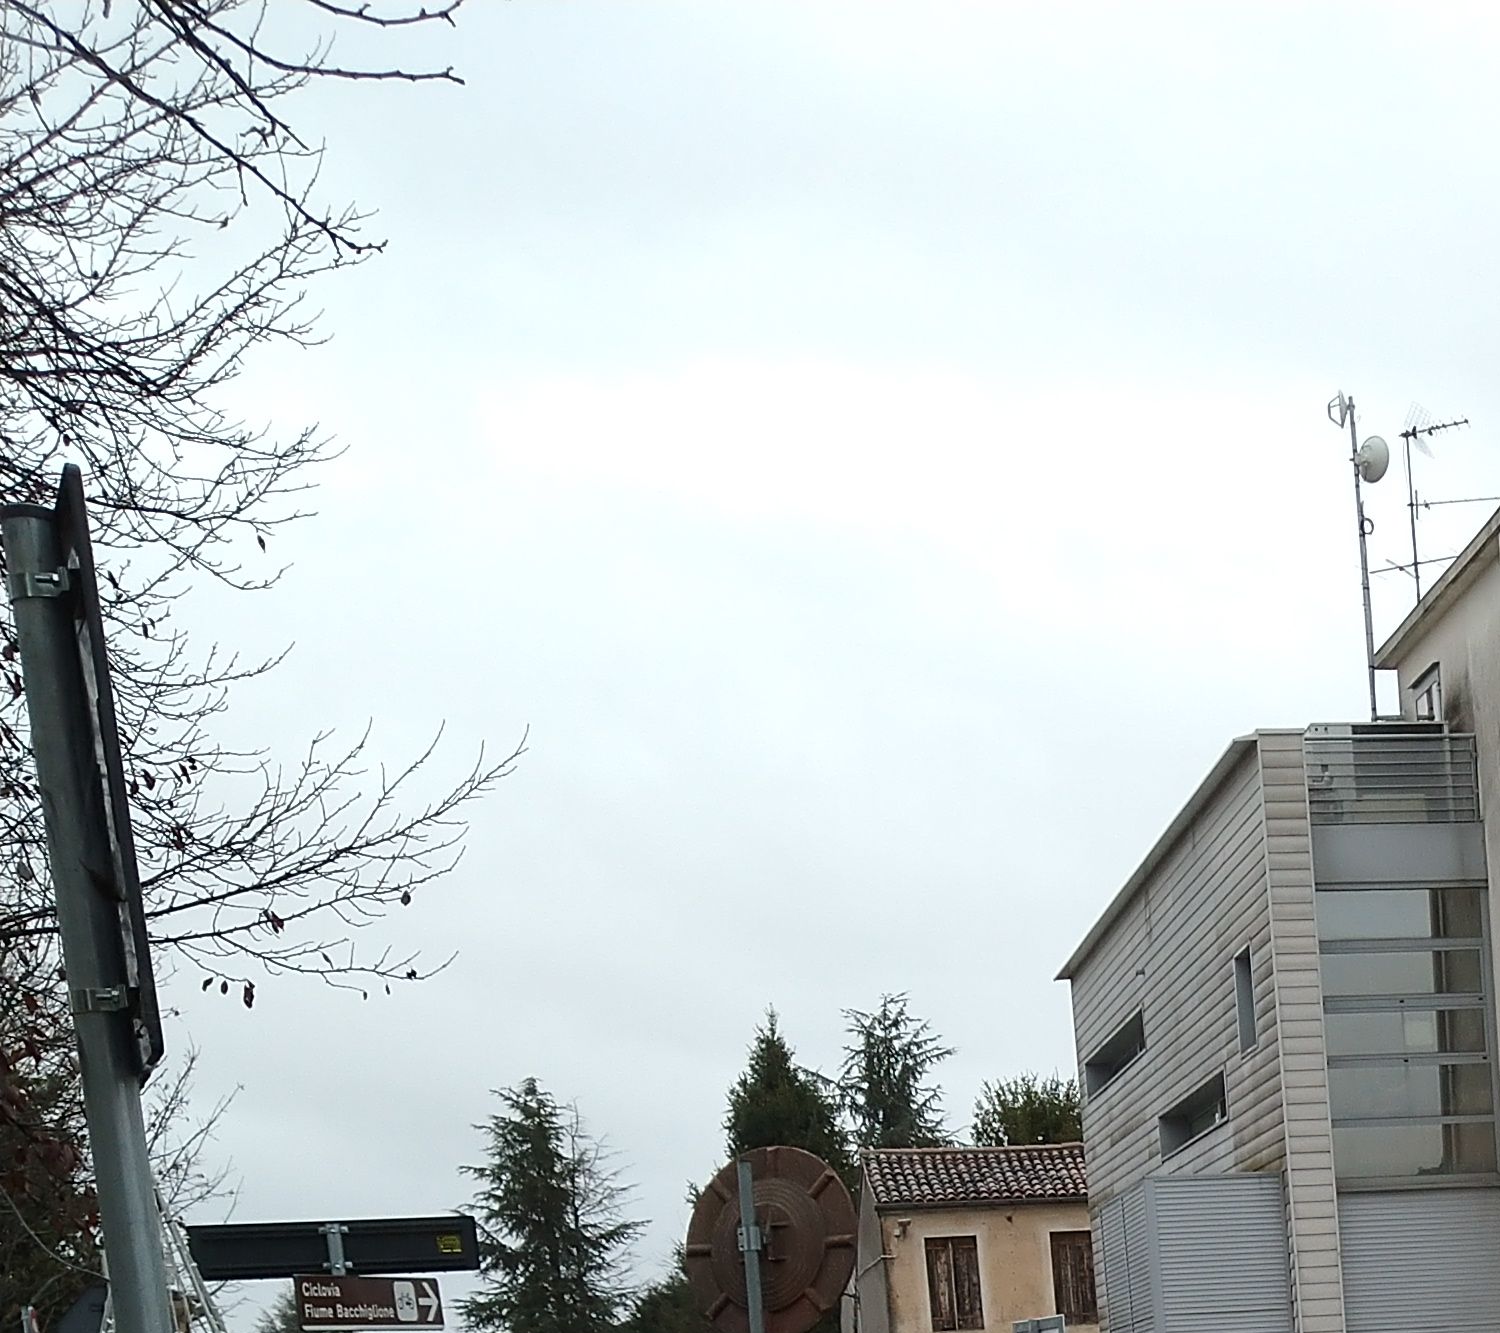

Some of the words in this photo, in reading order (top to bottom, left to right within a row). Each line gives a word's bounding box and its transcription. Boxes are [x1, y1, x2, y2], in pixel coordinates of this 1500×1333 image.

[301, 1281, 341, 1298] Ciclovia
[304, 1303, 334, 1319] Fiume
[335, 1303, 395, 1321] Bacchiglione
